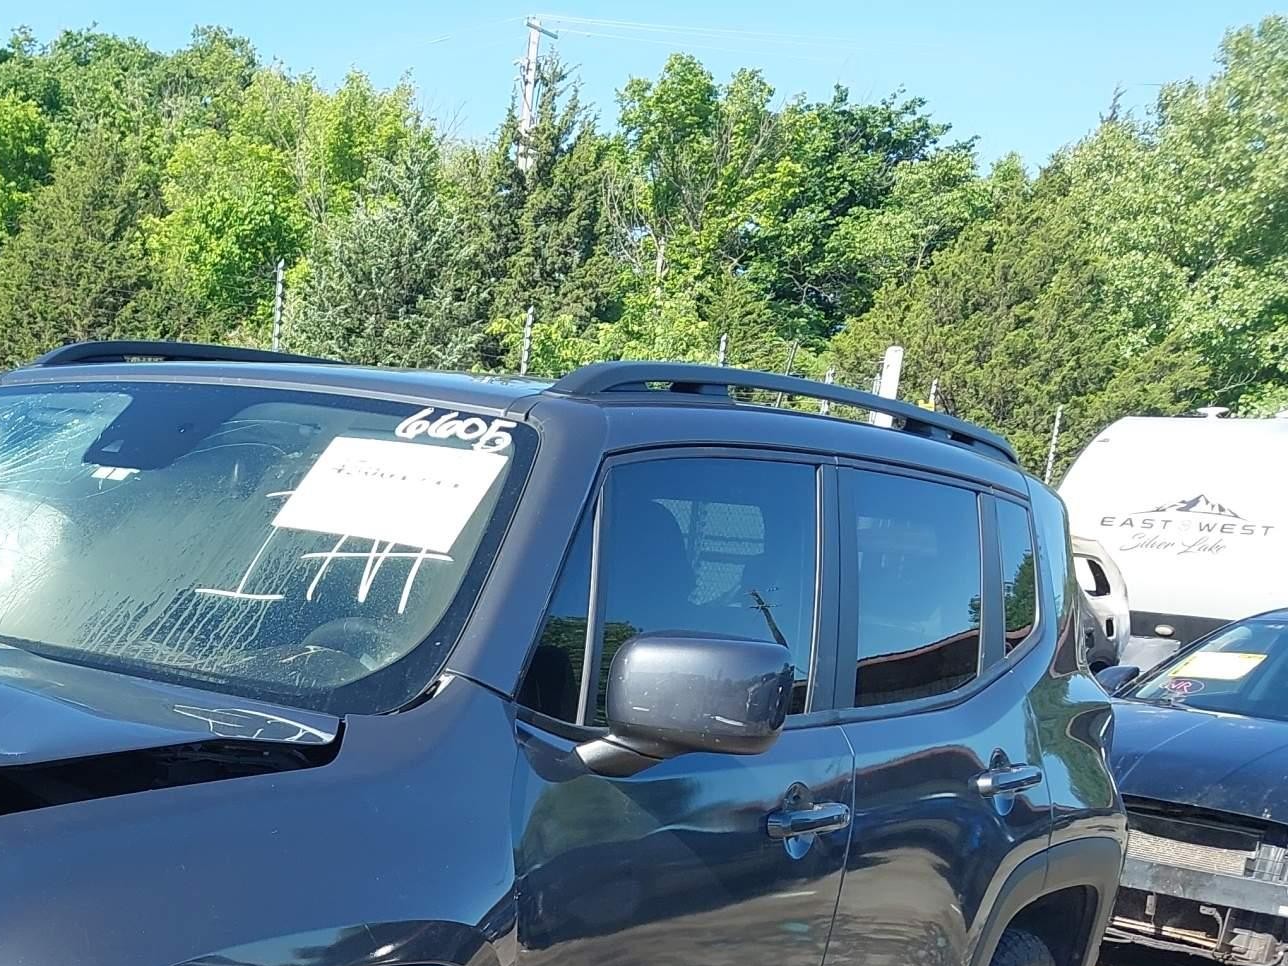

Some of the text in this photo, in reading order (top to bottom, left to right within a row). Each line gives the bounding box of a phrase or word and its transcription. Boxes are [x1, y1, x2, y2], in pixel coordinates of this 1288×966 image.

[395, 407, 517, 453] 6605
[1100, 516, 1276, 537] EAST WEST
[1119, 533, 1228, 556] Silver Lake
